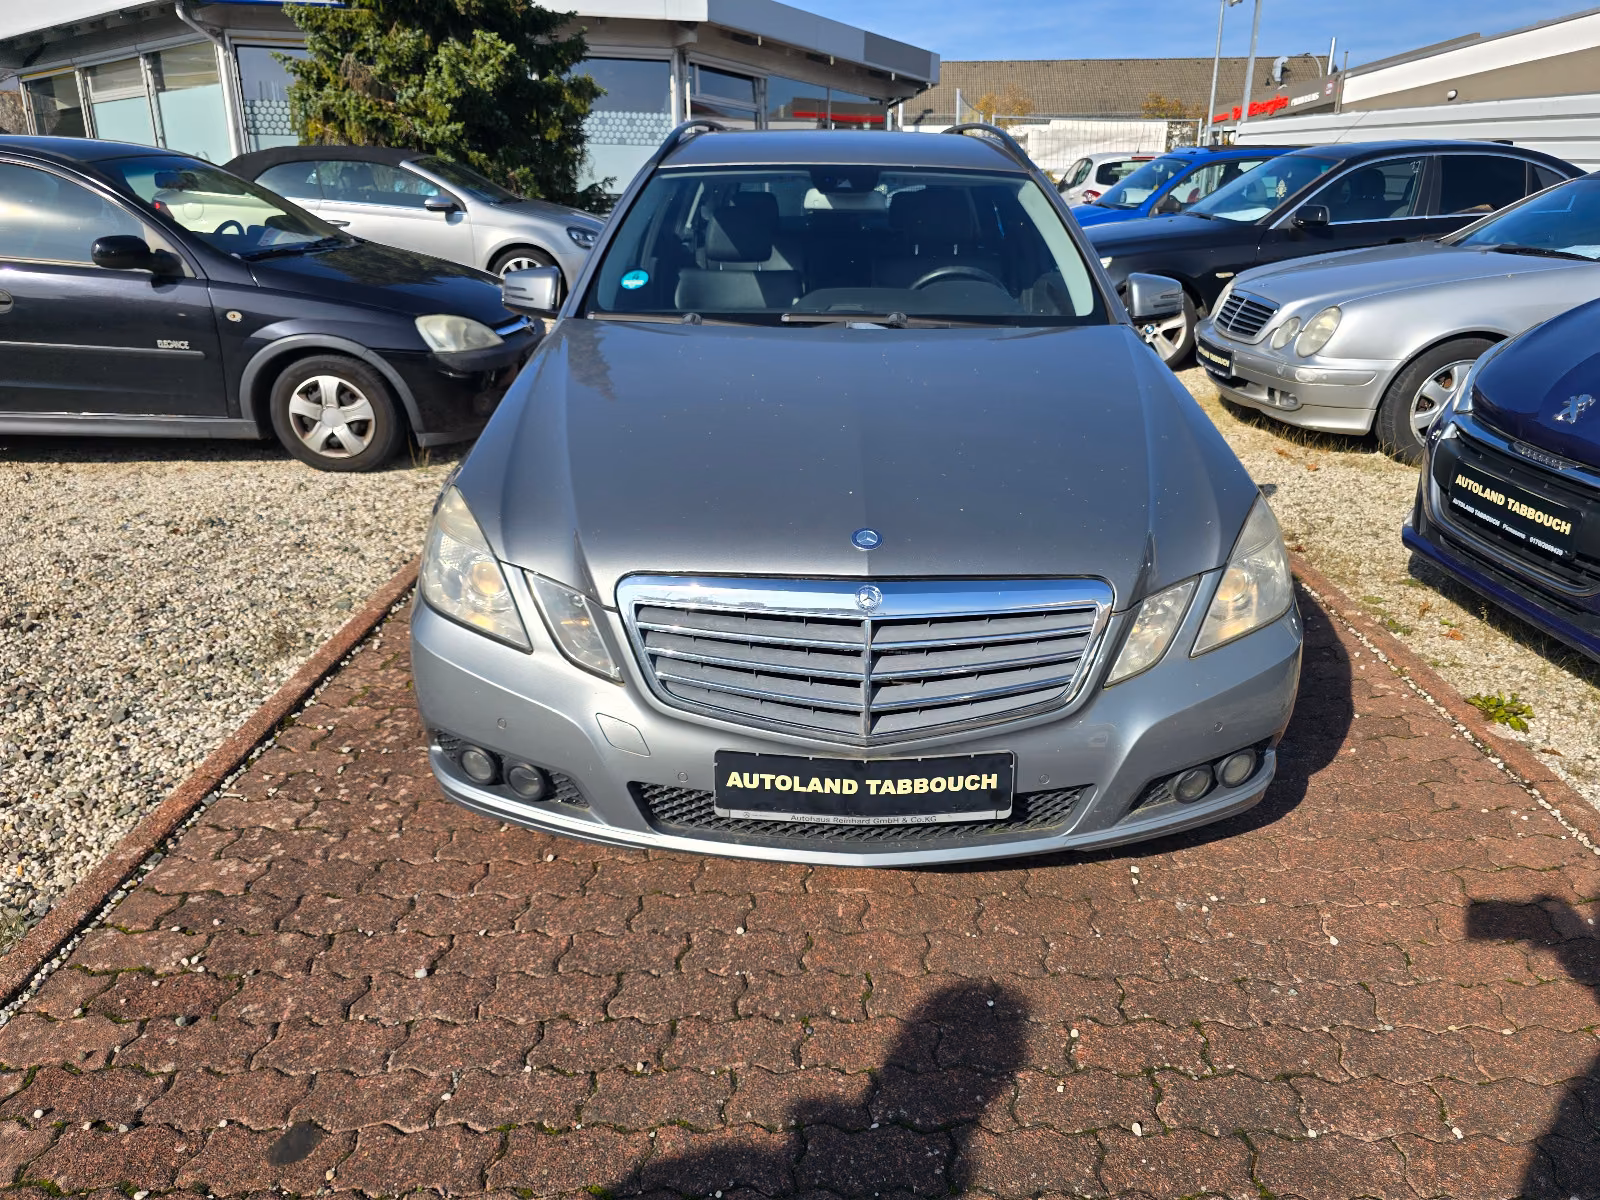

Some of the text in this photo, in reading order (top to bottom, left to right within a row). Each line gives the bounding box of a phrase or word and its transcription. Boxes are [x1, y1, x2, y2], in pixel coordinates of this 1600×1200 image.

[1455, 473, 1572, 535] AUTOLAND TABBOUCH
[726, 772, 998, 795] AUTOLAND TABBOUCH
[790, 815, 830, 823] Autohaus
